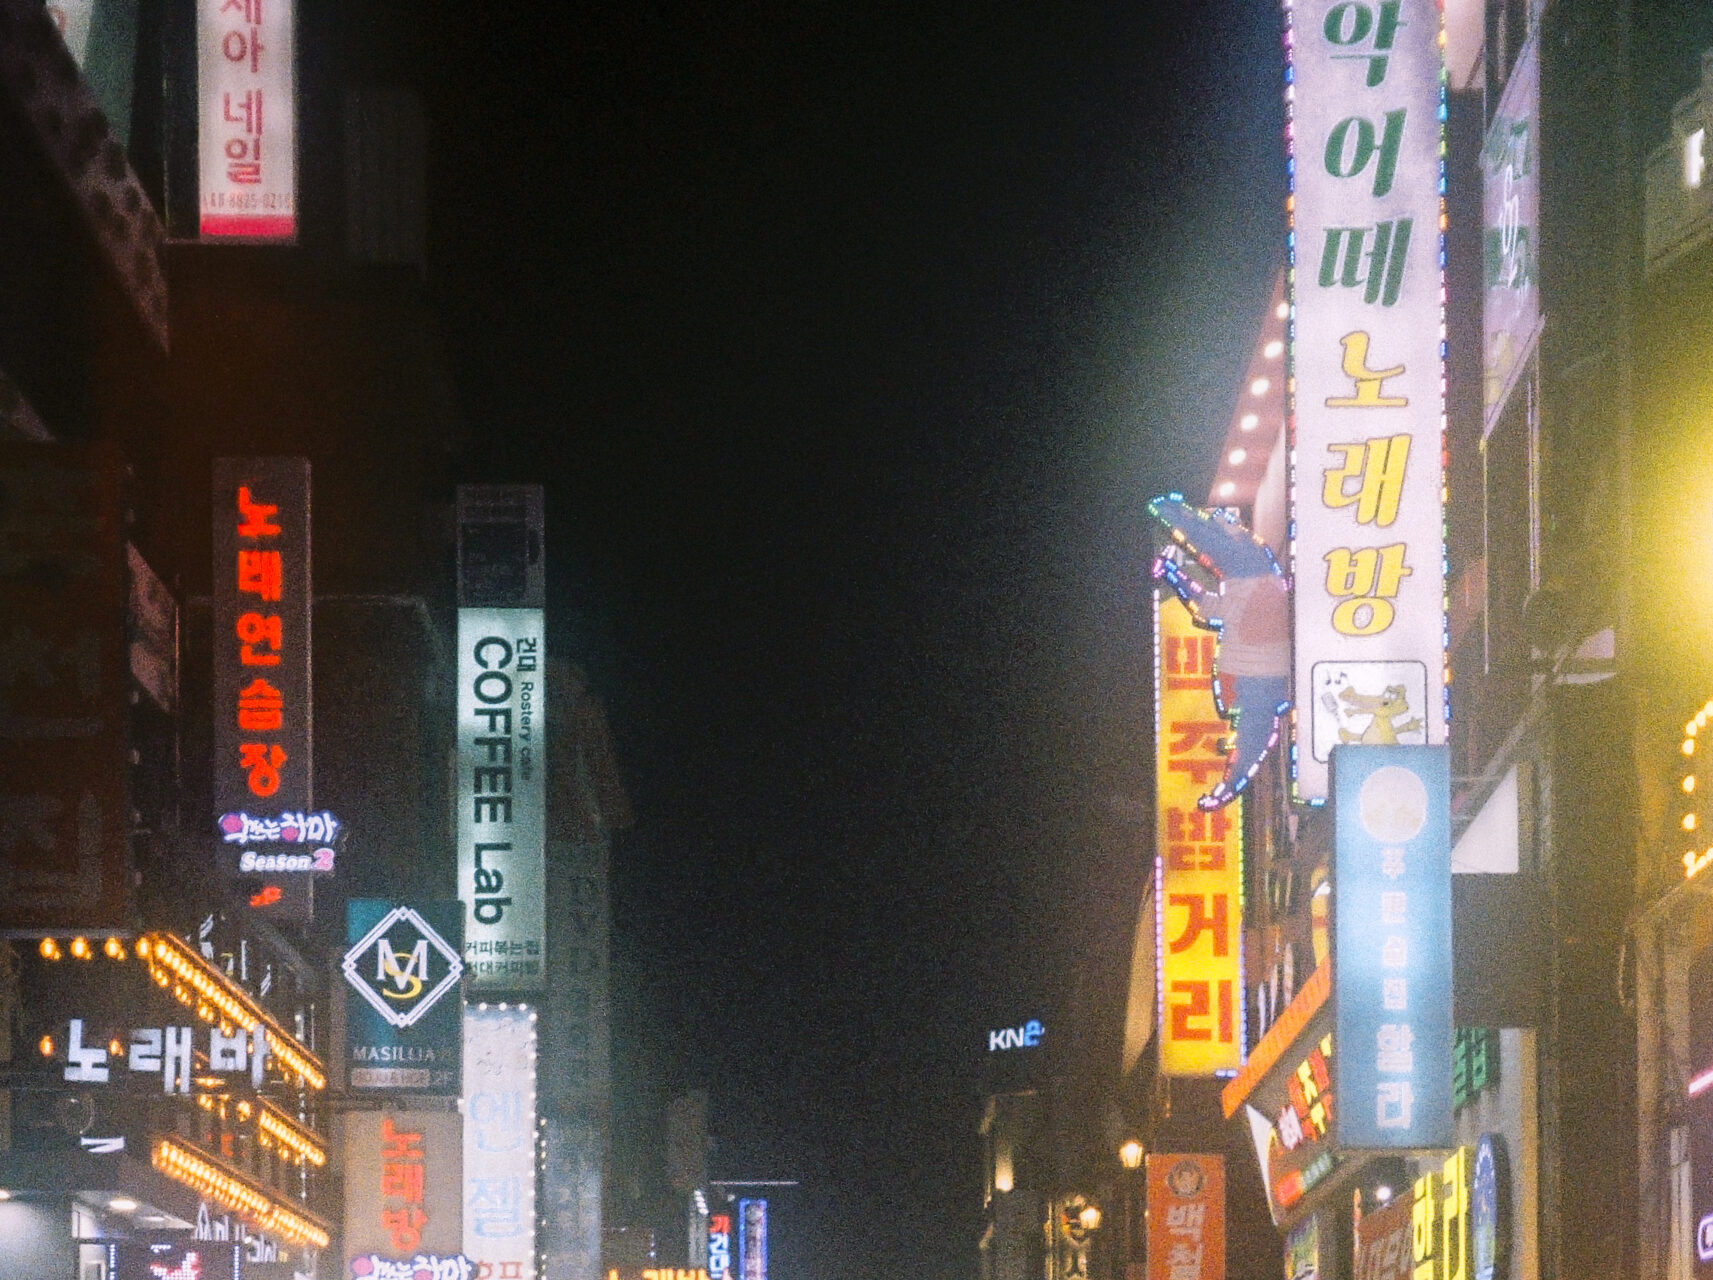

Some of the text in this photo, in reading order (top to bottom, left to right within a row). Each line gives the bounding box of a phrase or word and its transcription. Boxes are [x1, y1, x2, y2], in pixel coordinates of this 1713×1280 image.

[1319, 0, 1412, 637] 악어떼 노래방
[237, 487, 288, 797] 노래연습장
[516, 636, 537, 673] 건대
[518, 681, 534, 742] Rostery
[474, 636, 513, 926] COFFEE Lab
[240, 847, 336, 872] Season 2
[381, 1119, 429, 1252] 노래방
